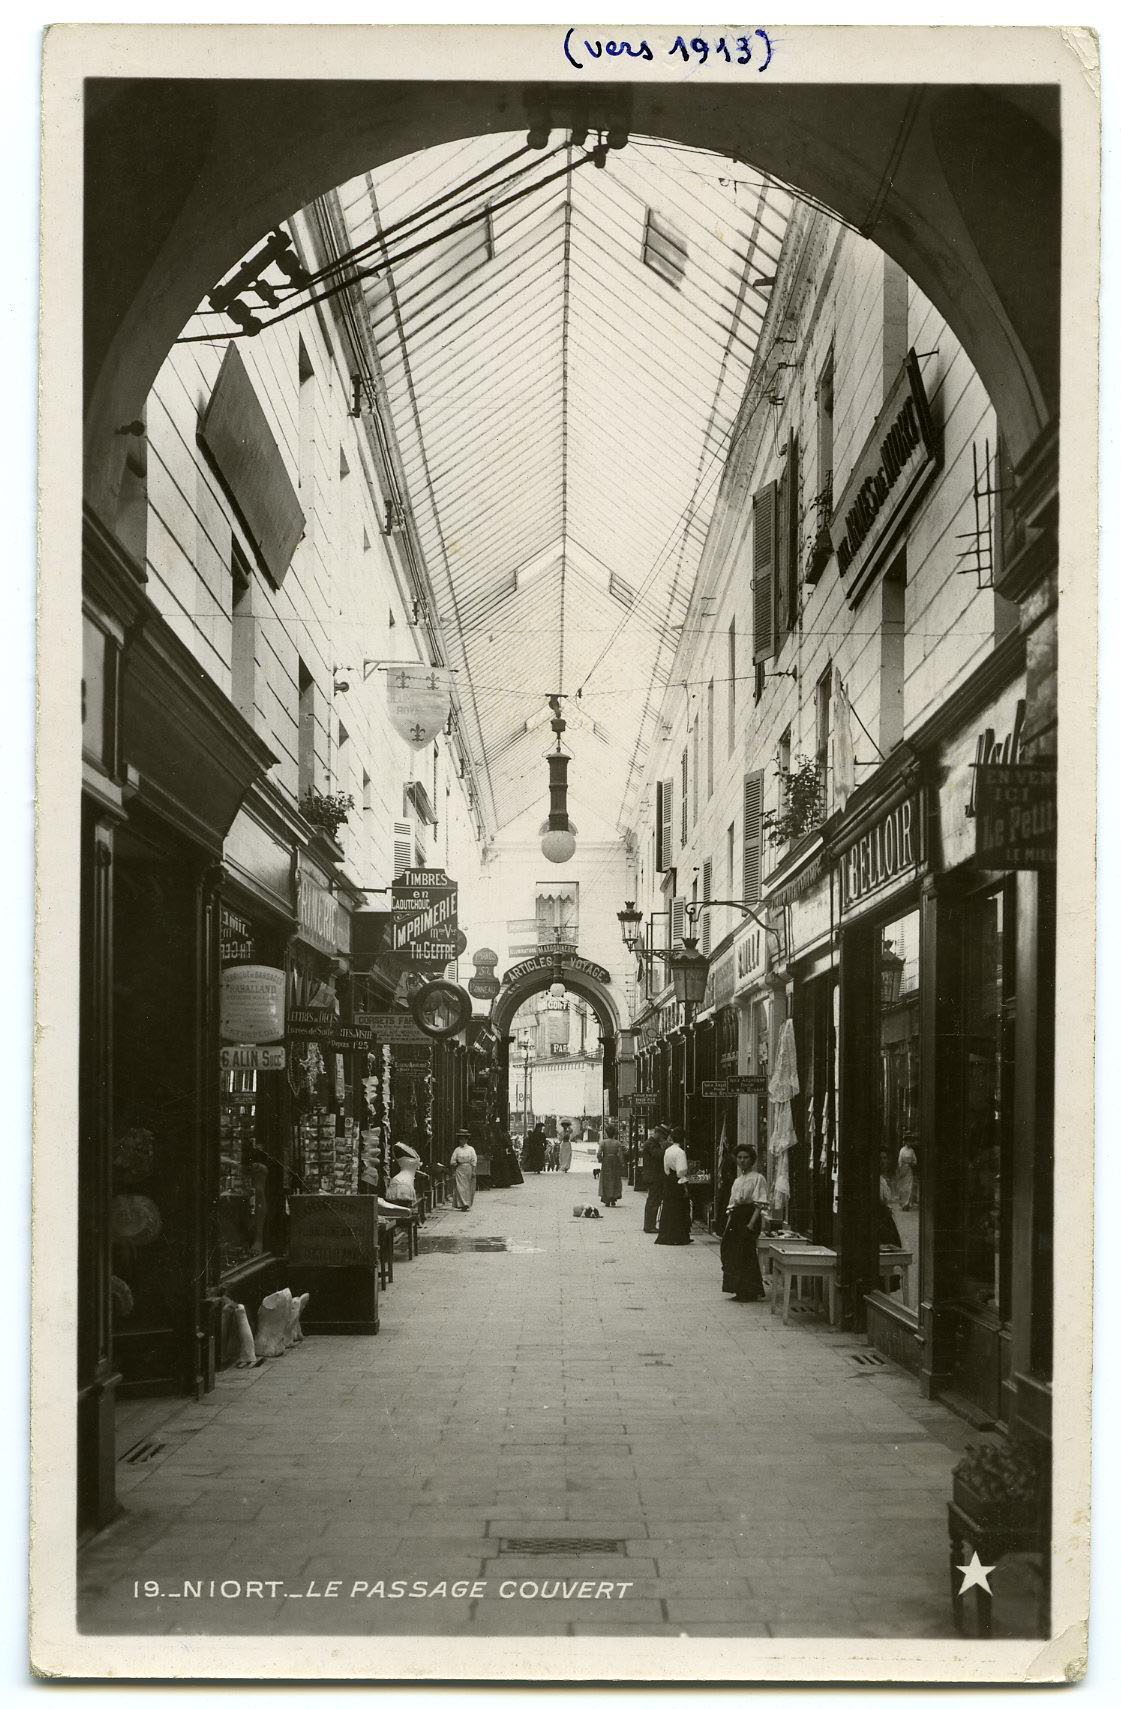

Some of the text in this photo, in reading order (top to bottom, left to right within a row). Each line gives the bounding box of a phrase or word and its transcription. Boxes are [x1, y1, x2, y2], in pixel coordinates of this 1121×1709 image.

[669, 29, 773, 71] 1913)
[404, 870, 448, 886] TIMBRES
[412, 890, 430, 899] en
[392, 896, 431, 911] CAOUTCHOUC
[393, 892, 457, 951] IMPRIMERIE
[507, 955, 553, 982] ARTICLES
[568, 956, 606, 981] VOYAGE
[358, 1015, 395, 1026] CORSETS
